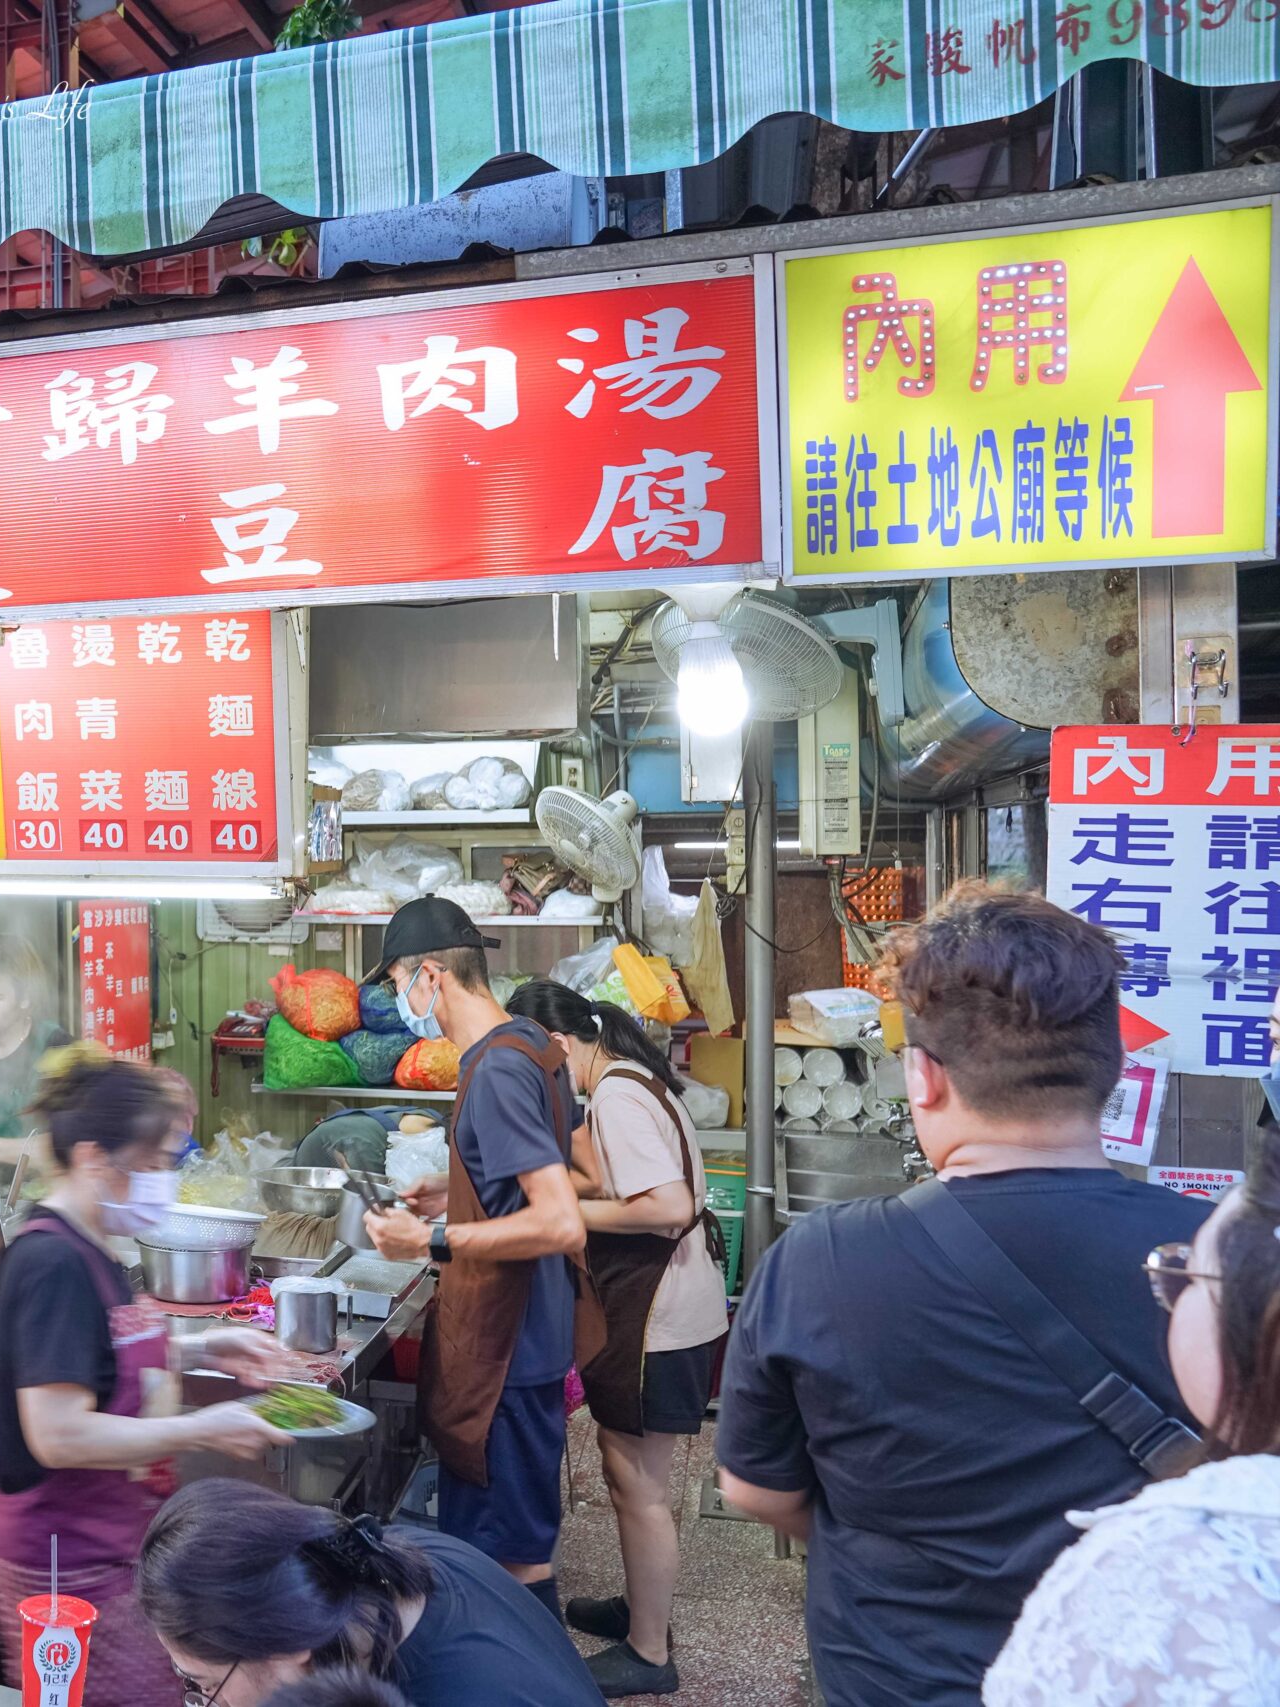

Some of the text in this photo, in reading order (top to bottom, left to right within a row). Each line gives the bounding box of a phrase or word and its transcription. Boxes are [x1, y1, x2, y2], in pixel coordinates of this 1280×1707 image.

[805, 415, 1133, 555] 請往土地公廟等候
[8, 627, 60, 850] 魯肉飯 30
[71, 623, 125, 850] 燙青菜 40
[135, 620, 191, 852] 乾麵 40
[204, 617, 259, 851] 乾麵線 40
[1072, 736, 1280, 797] 內用
[1164, 1181, 1179, 1189] NO
